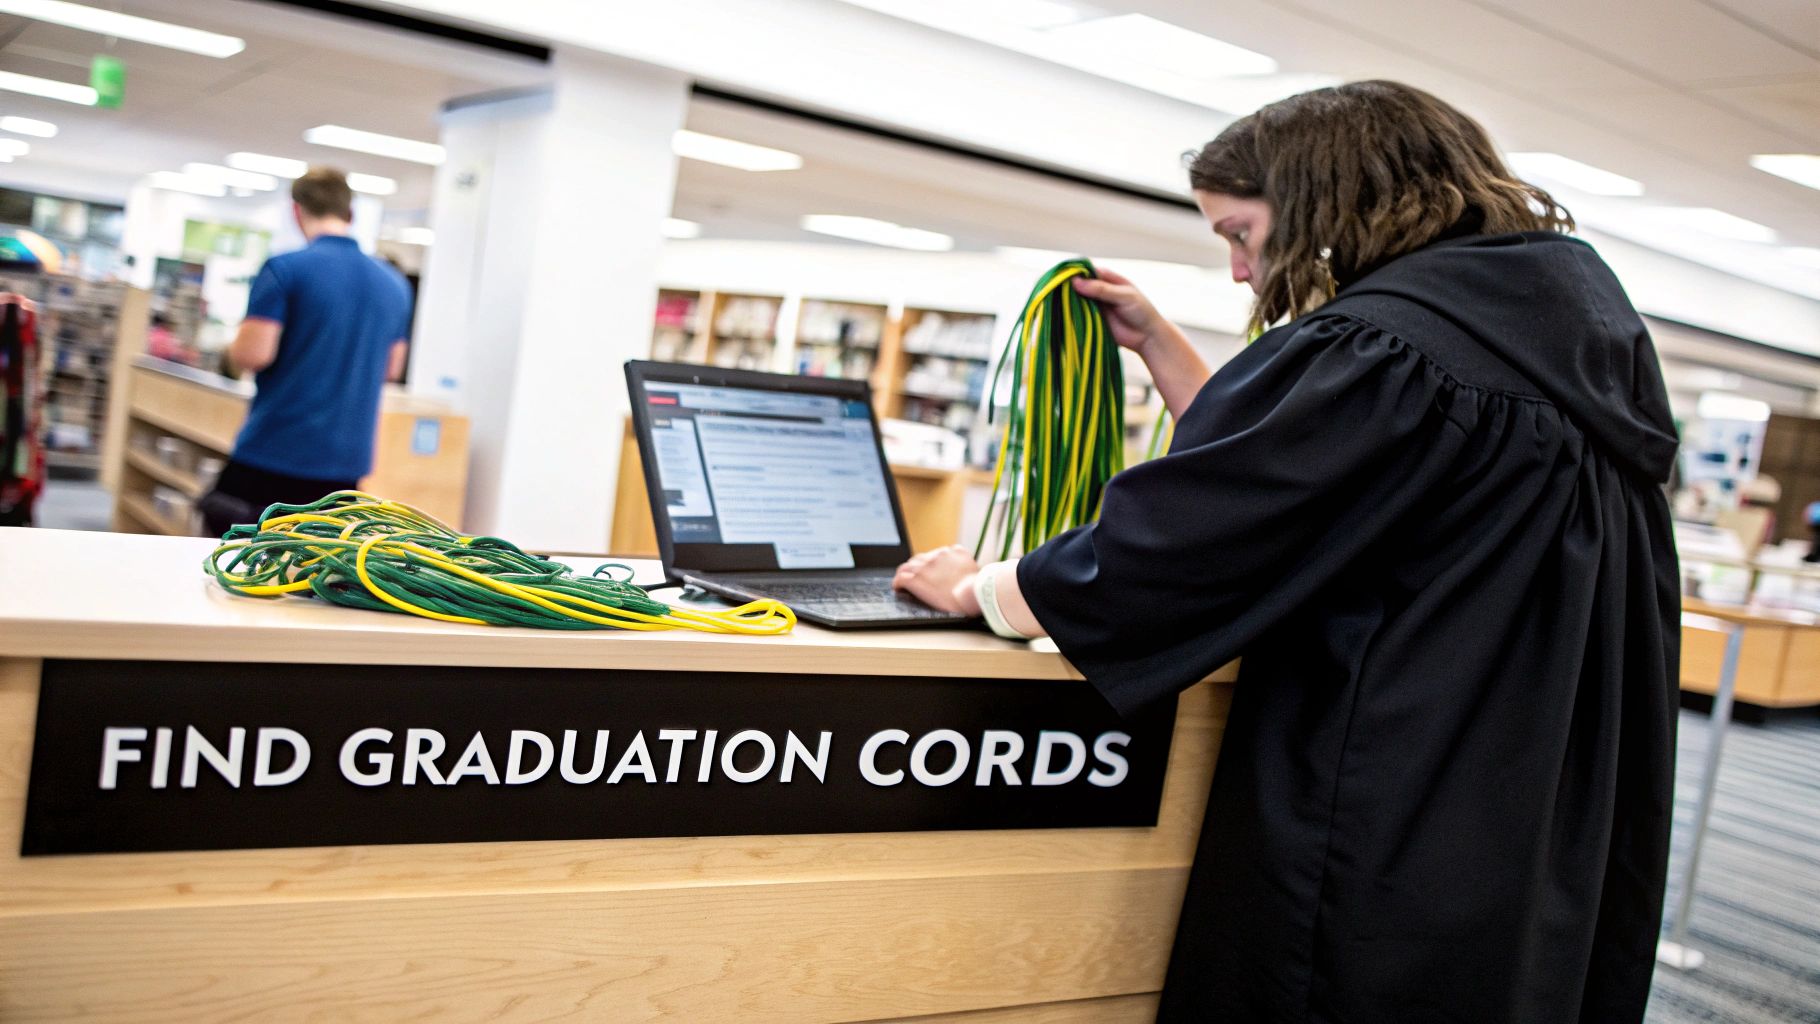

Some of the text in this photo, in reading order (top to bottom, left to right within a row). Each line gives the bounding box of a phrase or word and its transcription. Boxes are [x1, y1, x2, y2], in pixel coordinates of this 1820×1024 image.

[99, 726, 1131, 789] FIND GRADUATION CORDS
